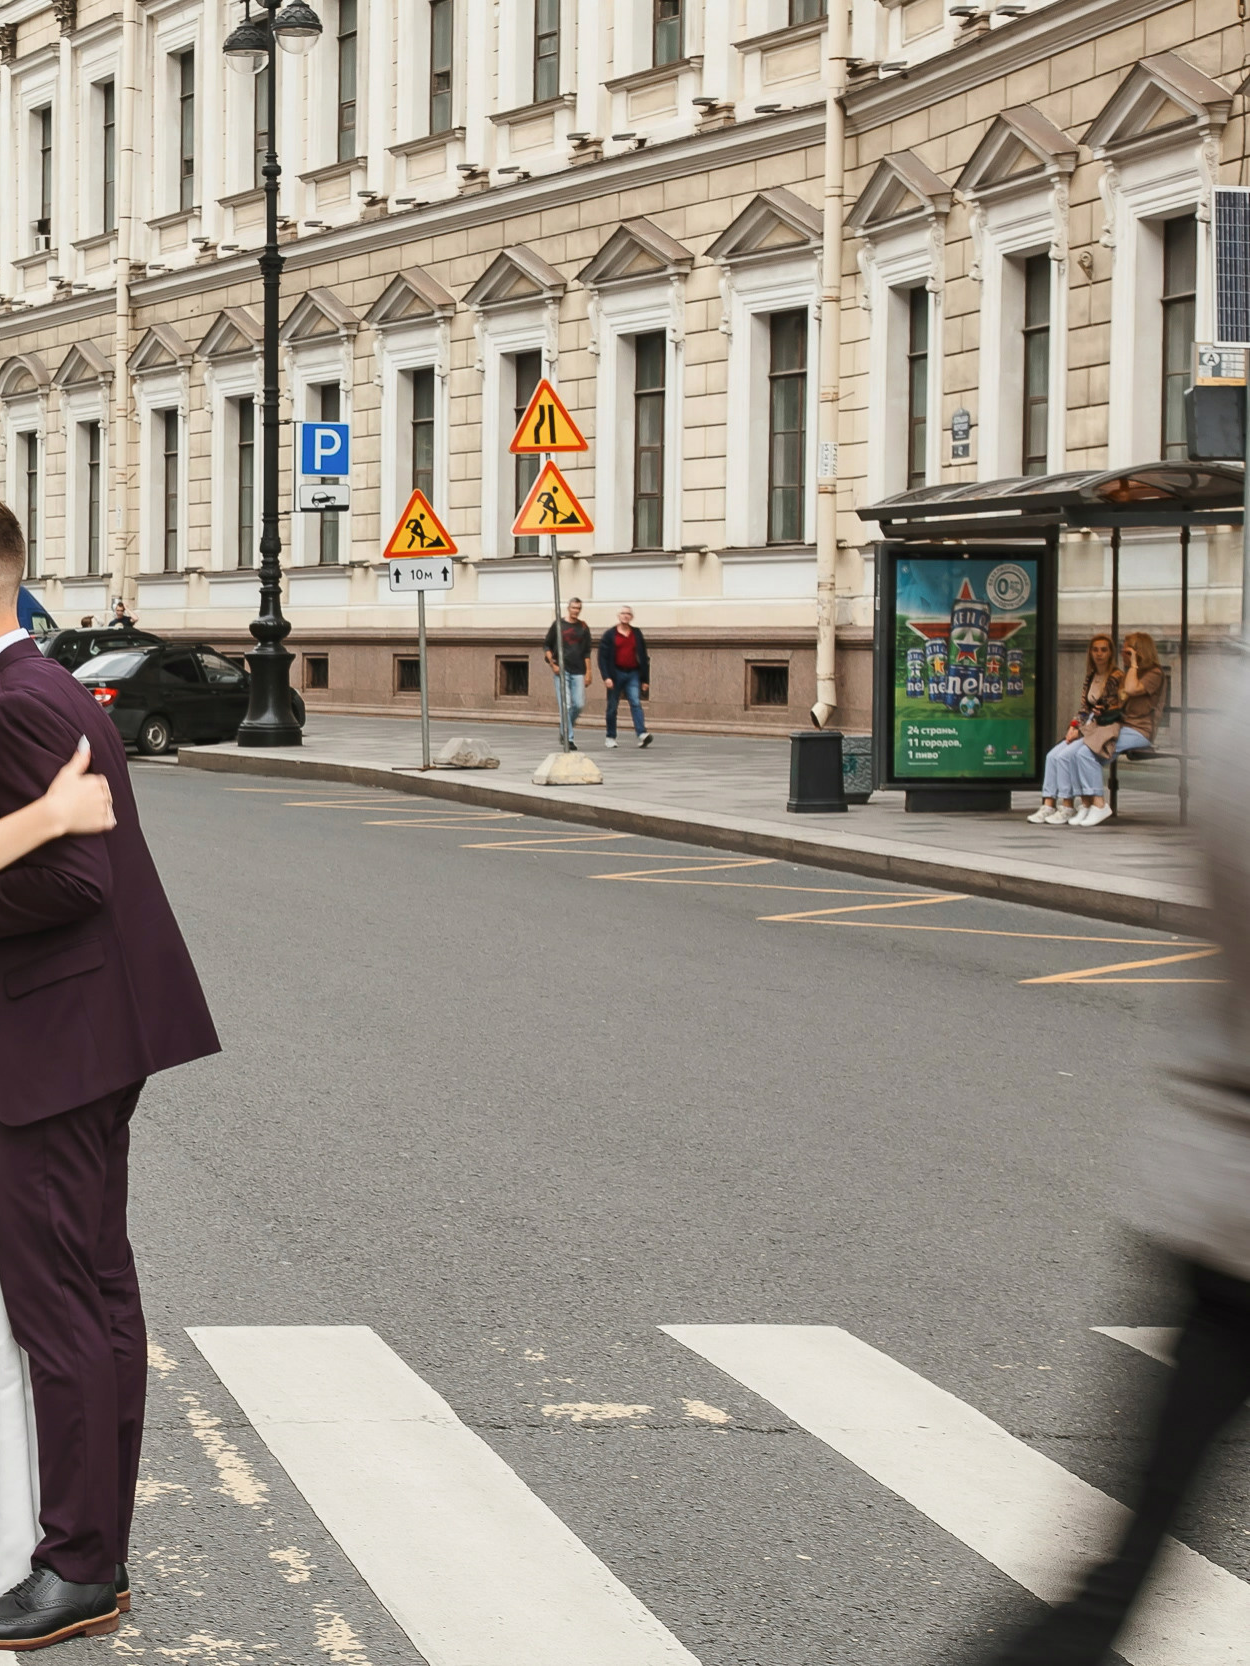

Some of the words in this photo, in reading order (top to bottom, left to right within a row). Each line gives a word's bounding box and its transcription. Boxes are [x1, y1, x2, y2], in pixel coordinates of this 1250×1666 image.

[314, 428, 342, 471] P
[907, 726, 919, 735] 24
[921, 727, 958, 736] страны,
[908, 738, 919, 747] 11
[921, 740, 962, 748] городов,
